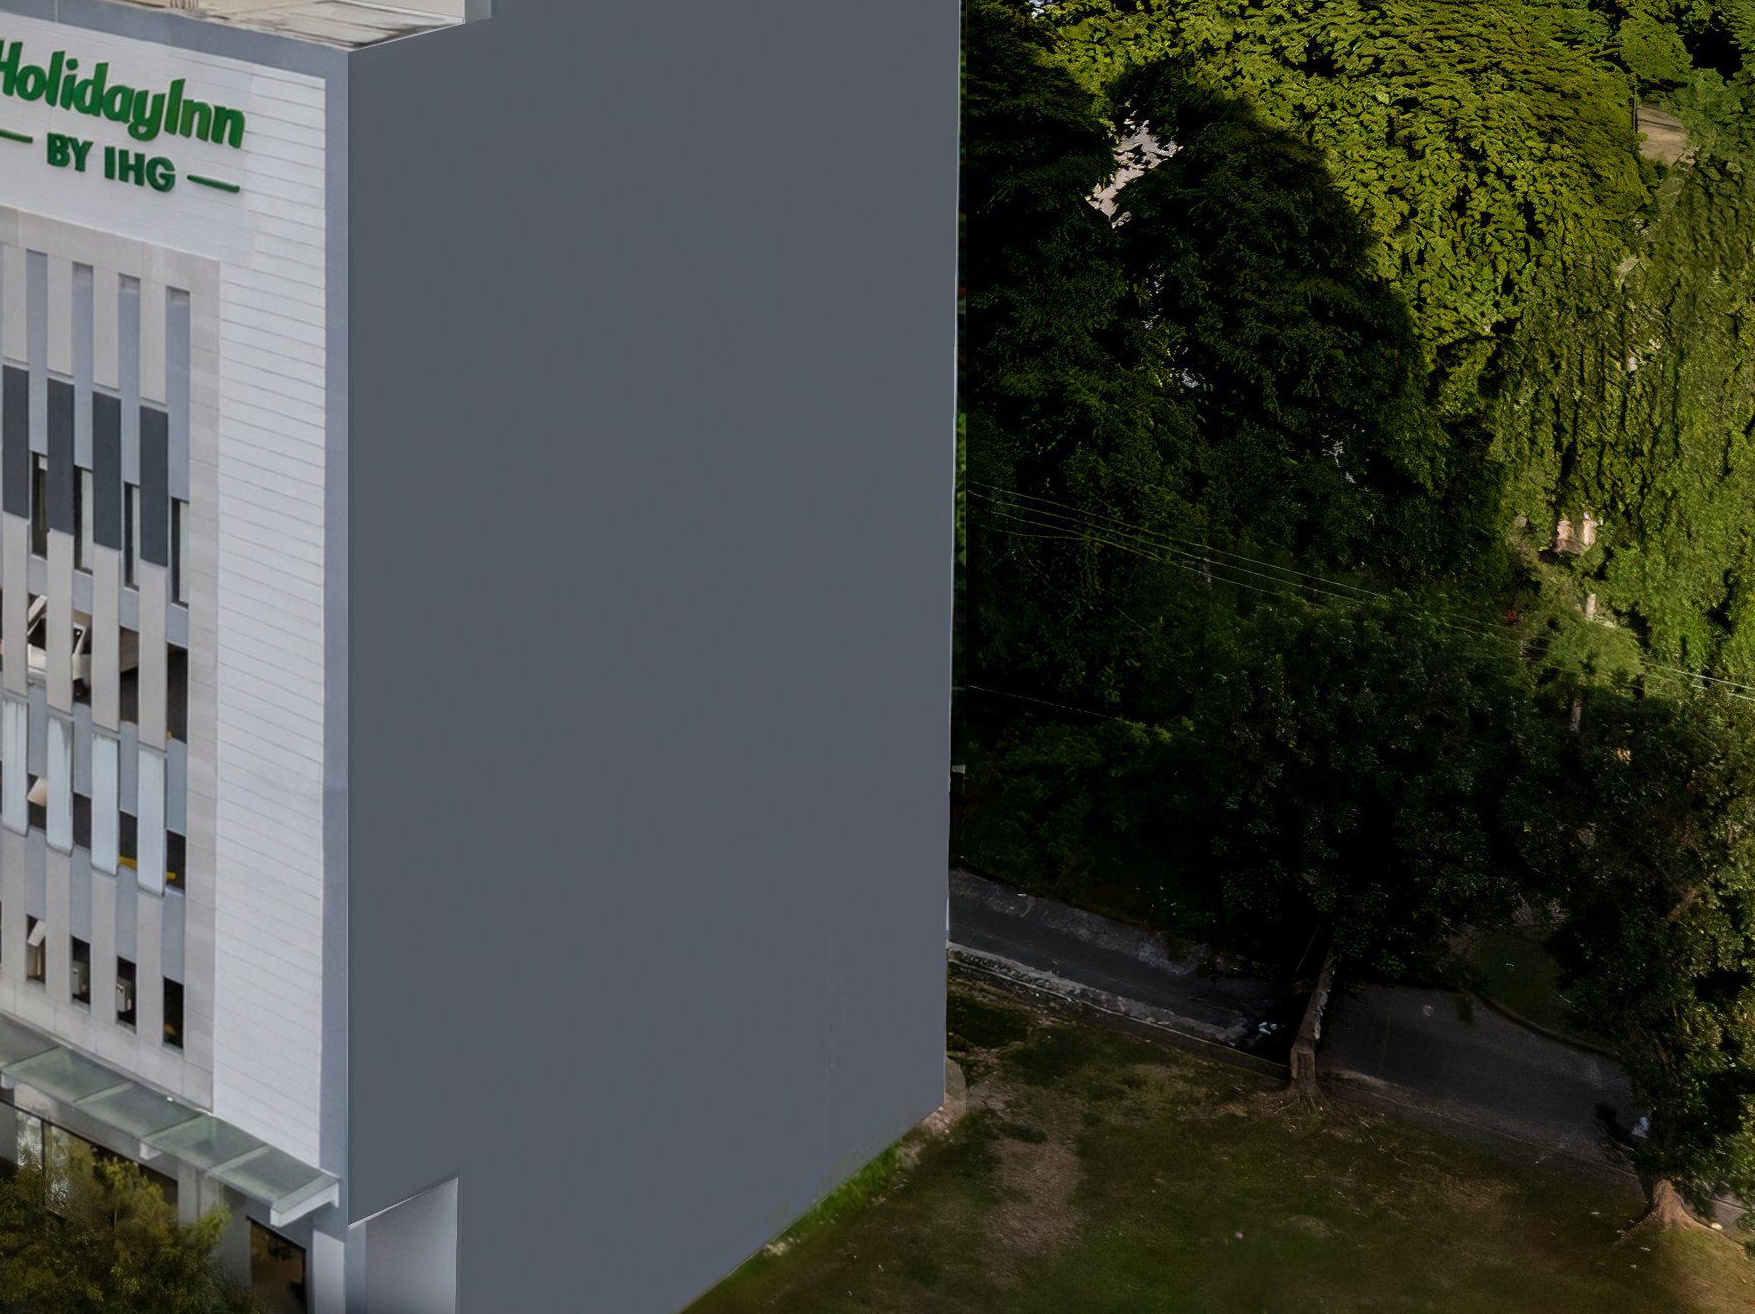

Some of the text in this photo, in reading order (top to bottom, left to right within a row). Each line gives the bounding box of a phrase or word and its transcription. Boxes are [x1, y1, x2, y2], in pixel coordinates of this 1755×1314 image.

[164, 78, 245, 149] Inn
[46, 132, 177, 193] BY IHG
